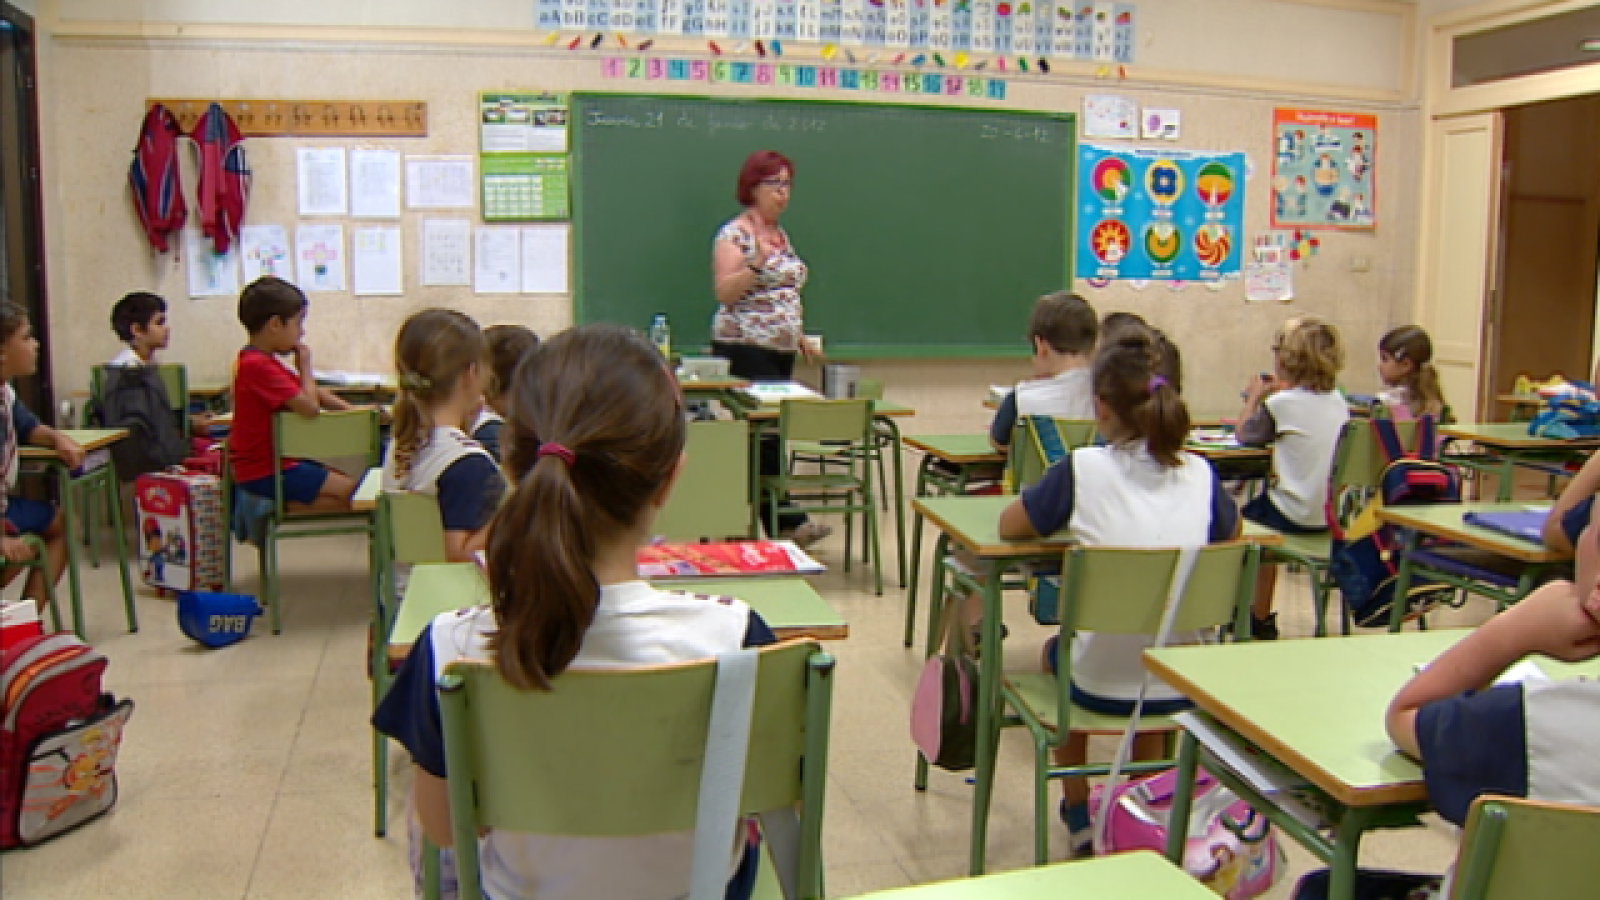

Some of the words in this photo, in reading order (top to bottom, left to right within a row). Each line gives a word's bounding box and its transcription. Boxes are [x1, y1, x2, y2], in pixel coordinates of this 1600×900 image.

[608, 59, 617, 77] 1
[629, 59, 641, 78] 2
[653, 59, 663, 78] 3
[671, 60, 683, 79] 4
[692, 61, 704, 80] 5
[714, 61, 726, 80] 6
[734, 62, 749, 82] 7
[756, 64, 770, 84] 8
[780, 65, 790, 83] 9
[799, 67, 814, 86] 10
[820, 68, 836, 86] 11
